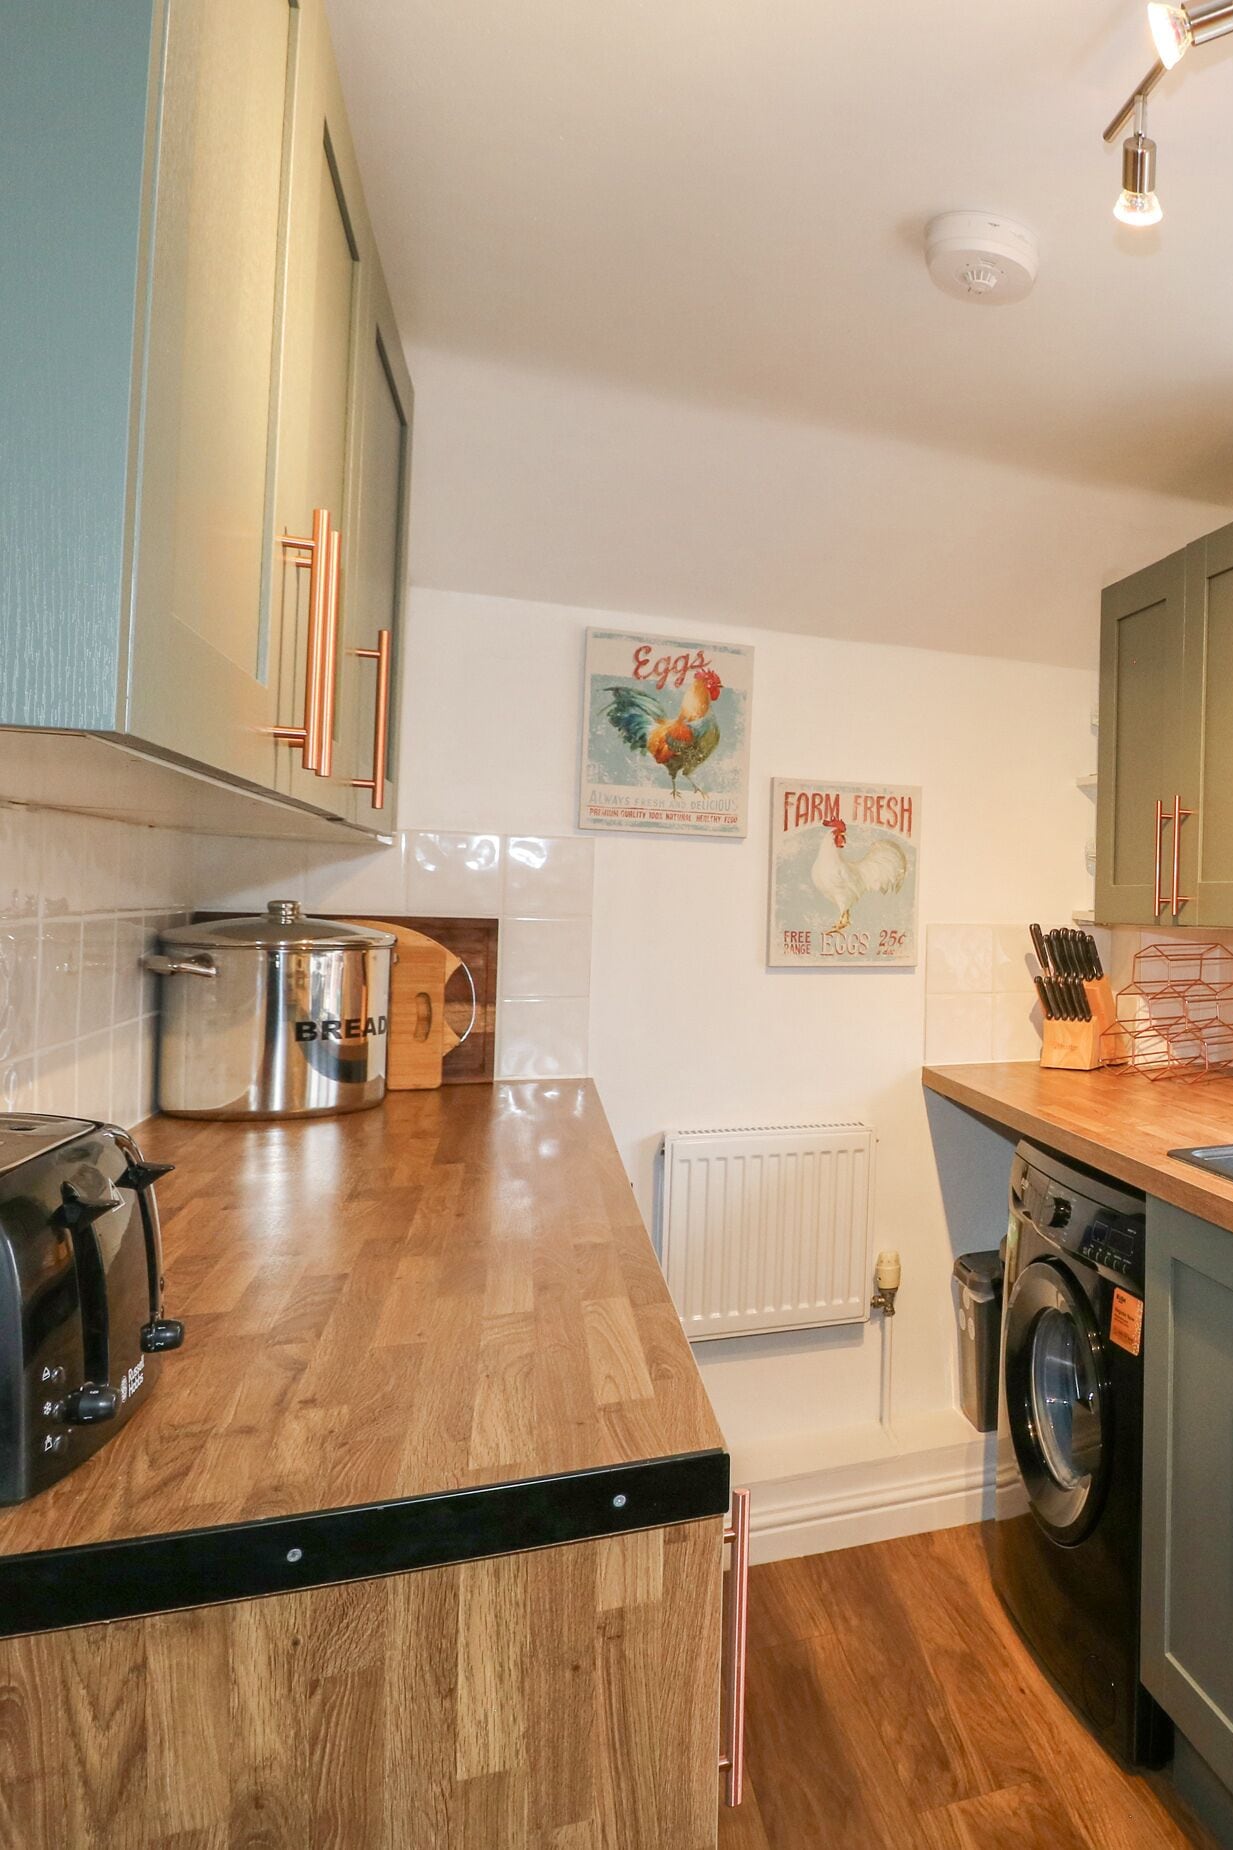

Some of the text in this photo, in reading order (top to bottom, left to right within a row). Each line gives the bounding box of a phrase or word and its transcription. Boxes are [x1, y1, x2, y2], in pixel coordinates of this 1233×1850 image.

[632, 645, 712, 690] Eggs
[783, 791, 913, 838] FARM FRESH
[783, 930, 811, 943] FREE
[820, 931, 870, 956] EGGS
[783, 943, 811, 955] RANGE
[295, 1015, 387, 1042] BREAD
